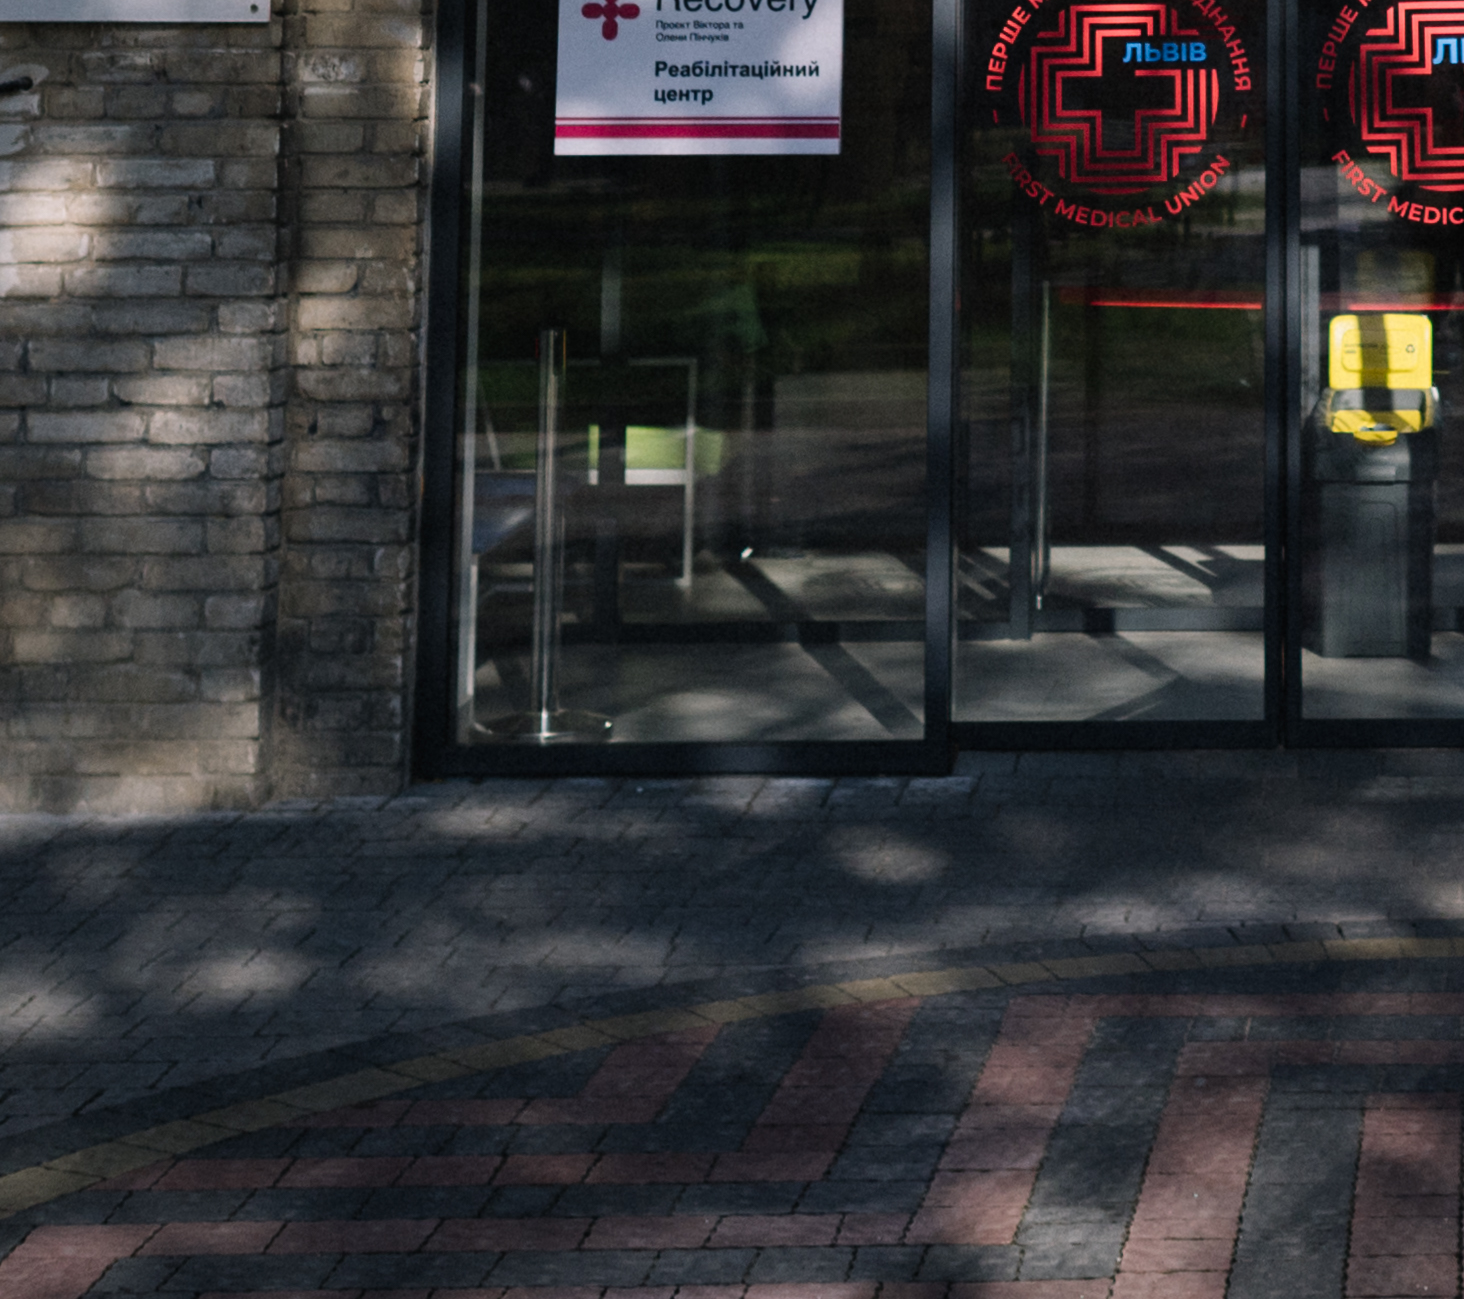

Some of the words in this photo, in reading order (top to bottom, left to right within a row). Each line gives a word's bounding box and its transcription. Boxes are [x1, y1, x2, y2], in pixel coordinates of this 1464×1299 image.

[693, 20, 731, 31] Віктора
[733, 21, 744, 30] та
[655, 32, 687, 43] Олени
[689, 32, 730, 43] Пінчуків
[1316, 4, 1359, 90] ПЕРШЕ
[986, 6, 1031, 91] ПЕРШЕ
[1122, 42, 1208, 63] ЛЬВІВ
[654, 60, 820, 80] Реабілітаційний
[653, 88, 714, 105] центр
[1331, 149, 1388, 203] FIRST
[1002, 152, 1055, 205] FIRST
[1054, 198, 1163, 228] MEDICAL
[1164, 154, 1231, 215] UNION
